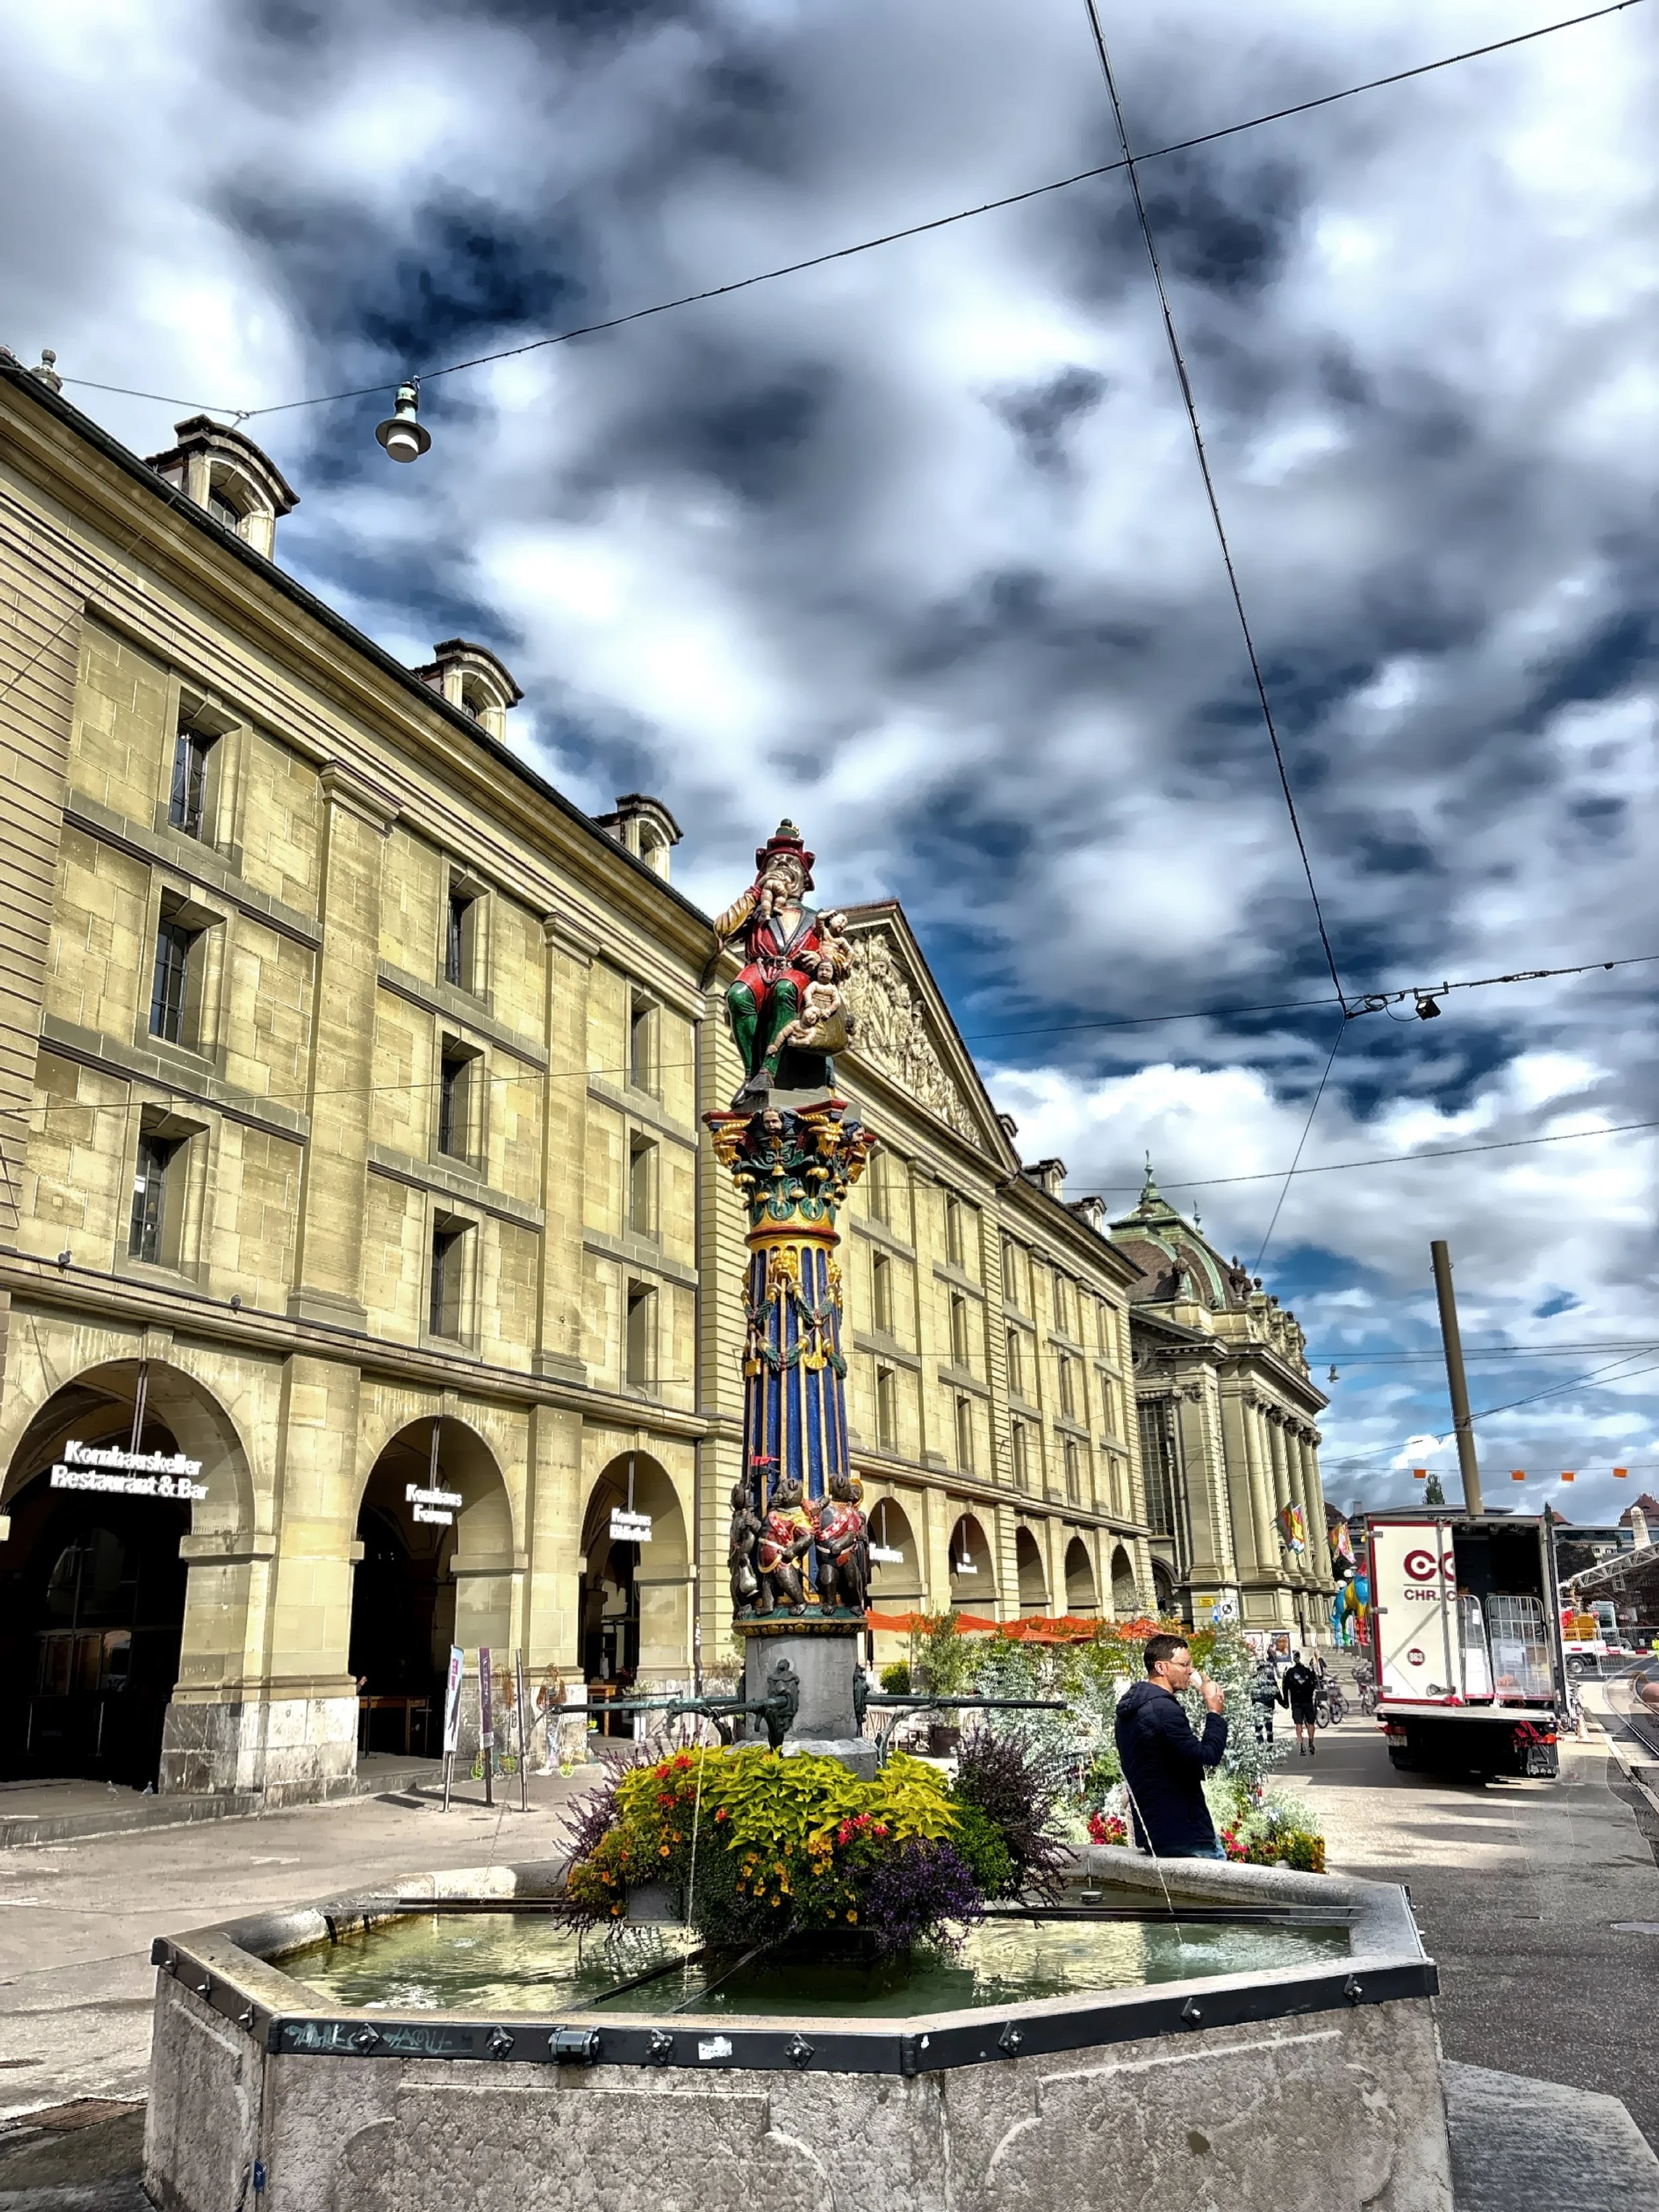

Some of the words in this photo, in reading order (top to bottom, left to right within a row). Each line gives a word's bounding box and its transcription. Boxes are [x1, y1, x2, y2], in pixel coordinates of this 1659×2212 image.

[64, 1440, 202, 1475] Kornhauskeller
[50, 1464, 157, 1495] Restaurant
[157, 1475, 177, 1497] &
[177, 1478, 208, 1499] Bar
[1404, 1589, 1441, 1601] CHR.
